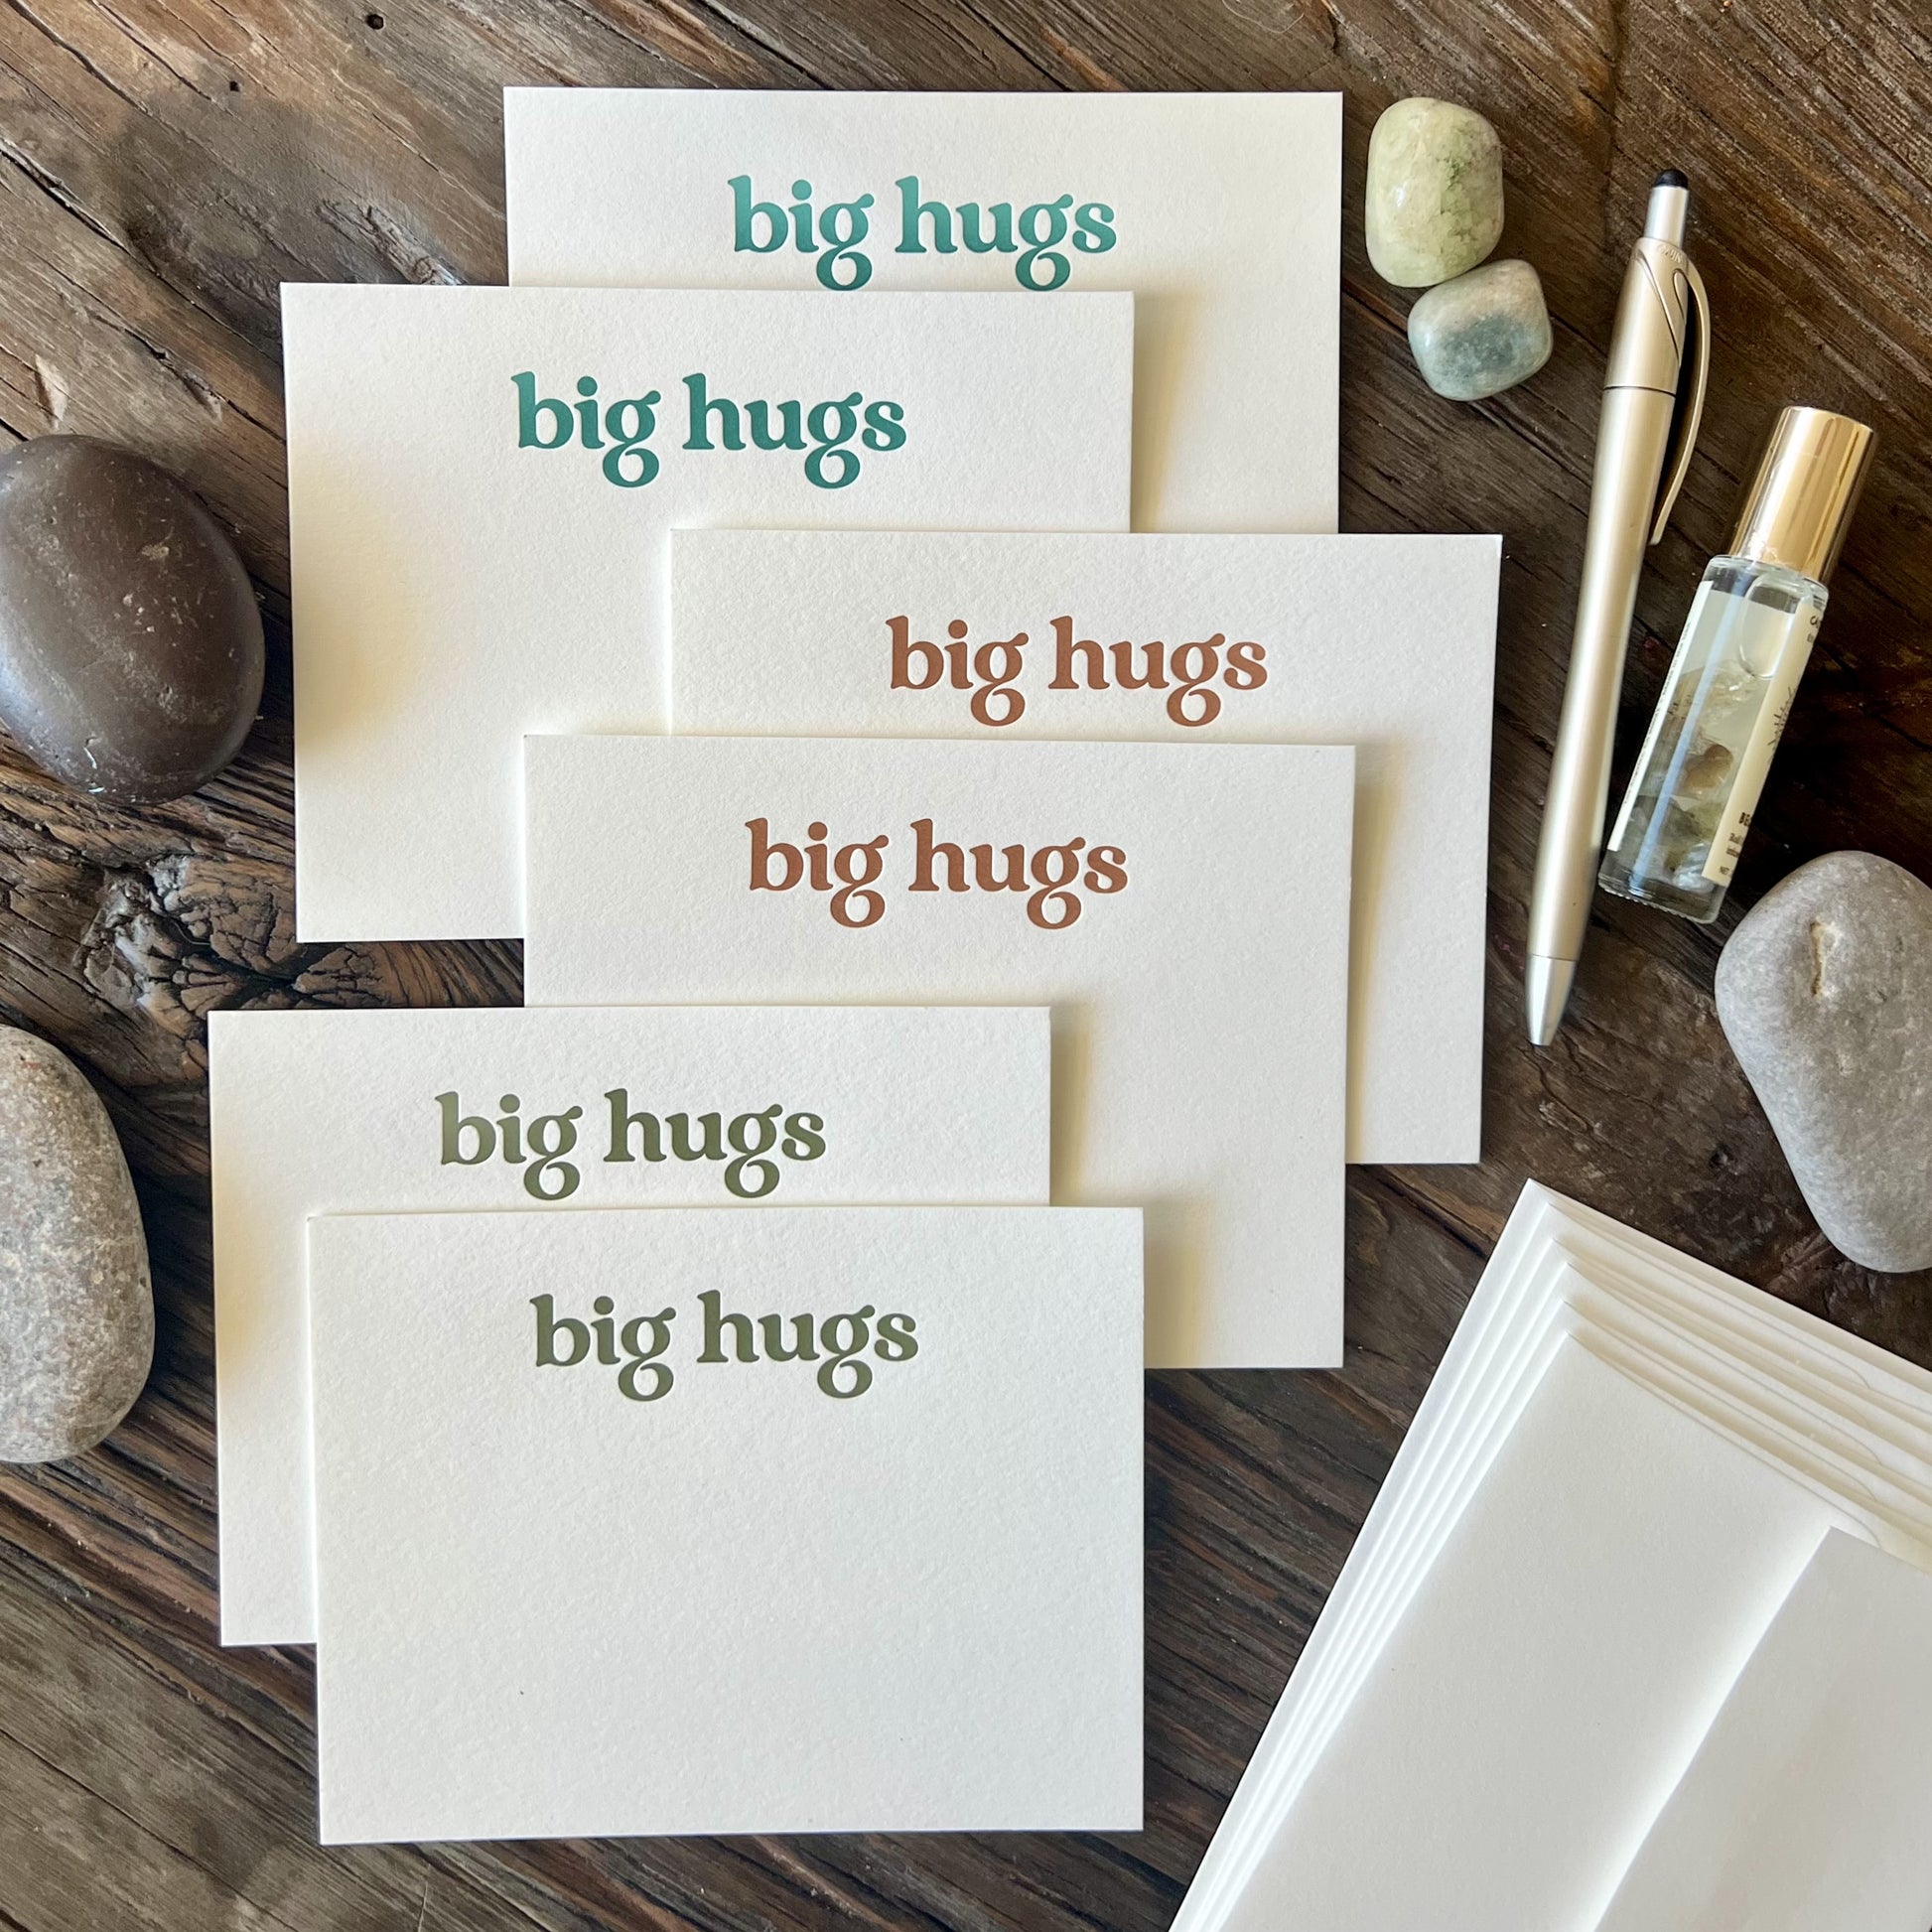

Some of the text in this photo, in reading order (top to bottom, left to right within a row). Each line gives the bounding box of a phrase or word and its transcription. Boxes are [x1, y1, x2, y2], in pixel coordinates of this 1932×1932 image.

[728, 175, 1117, 291] big hugs
[511, 371, 906, 488] big hugs
[886, 616, 1267, 727] big hugs
[745, 818, 1127, 929] big hugs
[435, 1088, 825, 1200] big hugs
[529, 1290, 918, 1402] big hugs
